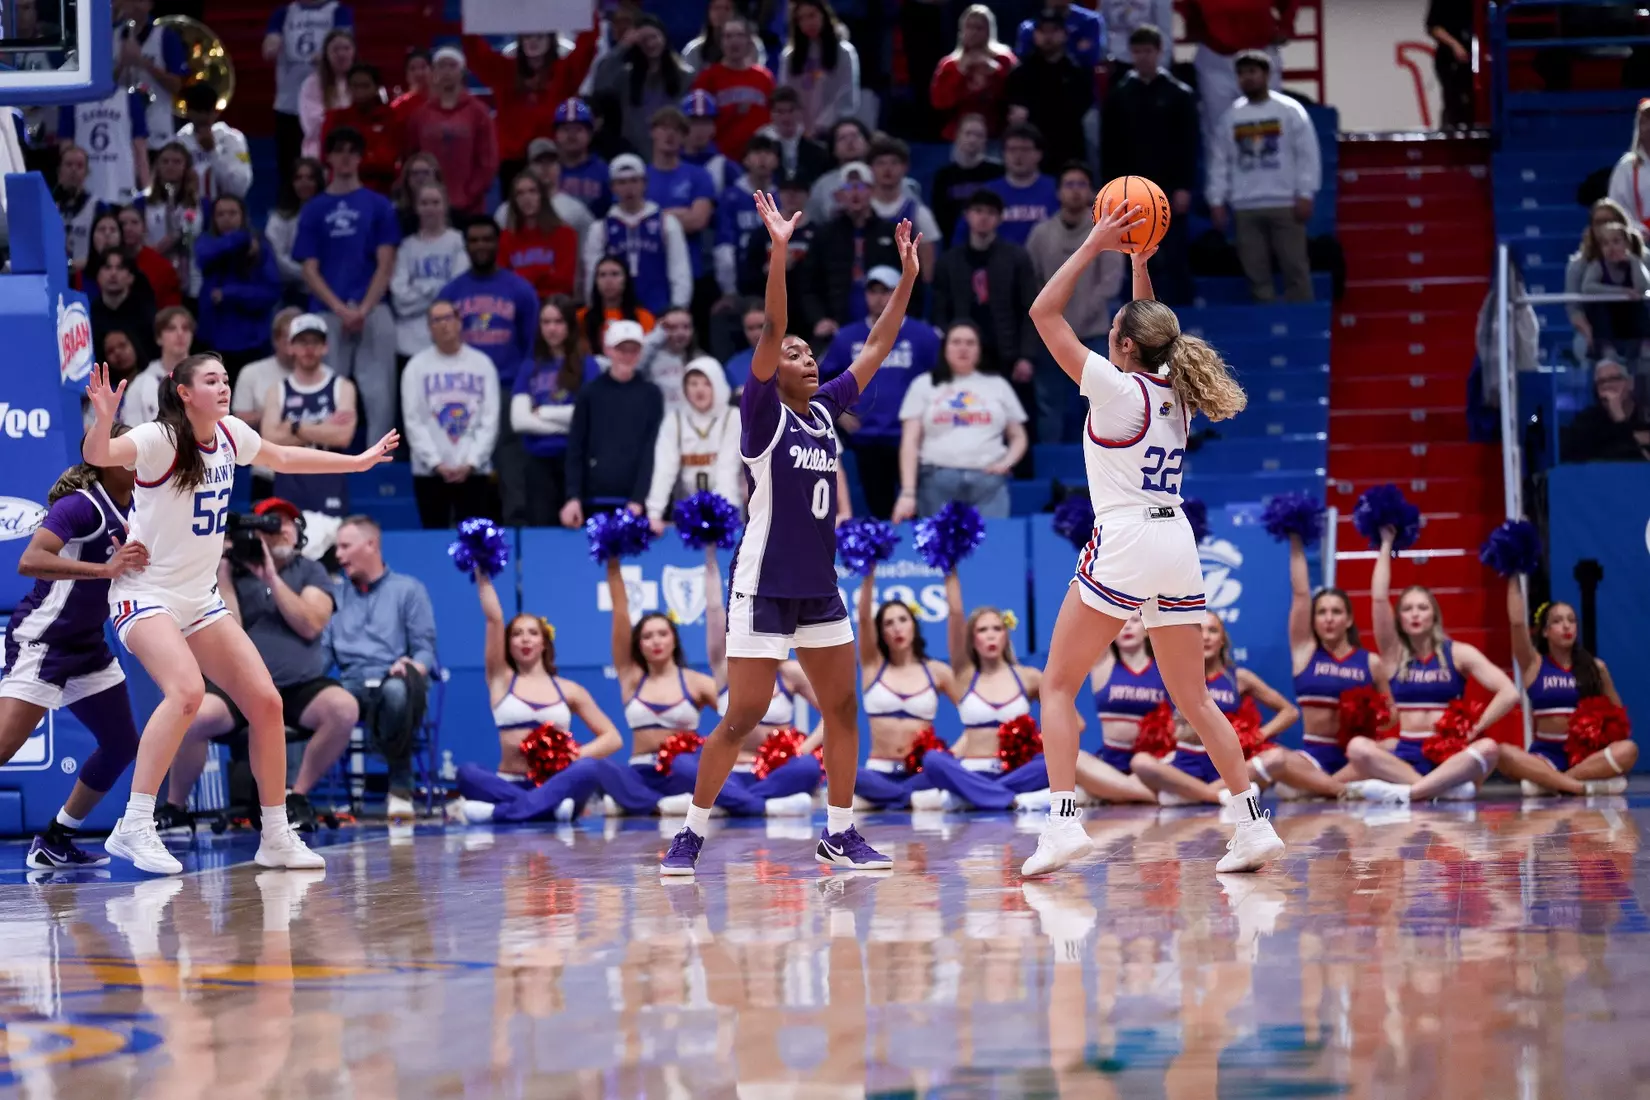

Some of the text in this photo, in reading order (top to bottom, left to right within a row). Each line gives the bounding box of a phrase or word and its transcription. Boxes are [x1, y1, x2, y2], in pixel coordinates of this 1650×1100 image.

[89, 123, 110, 153] 6
[424, 371, 485, 403] KANSAS
[1140, 446, 1184, 495] 22
[192, 487, 232, 536] 52
[811, 478, 830, 520] 0
[1543, 675, 1577, 692] JAYHA
